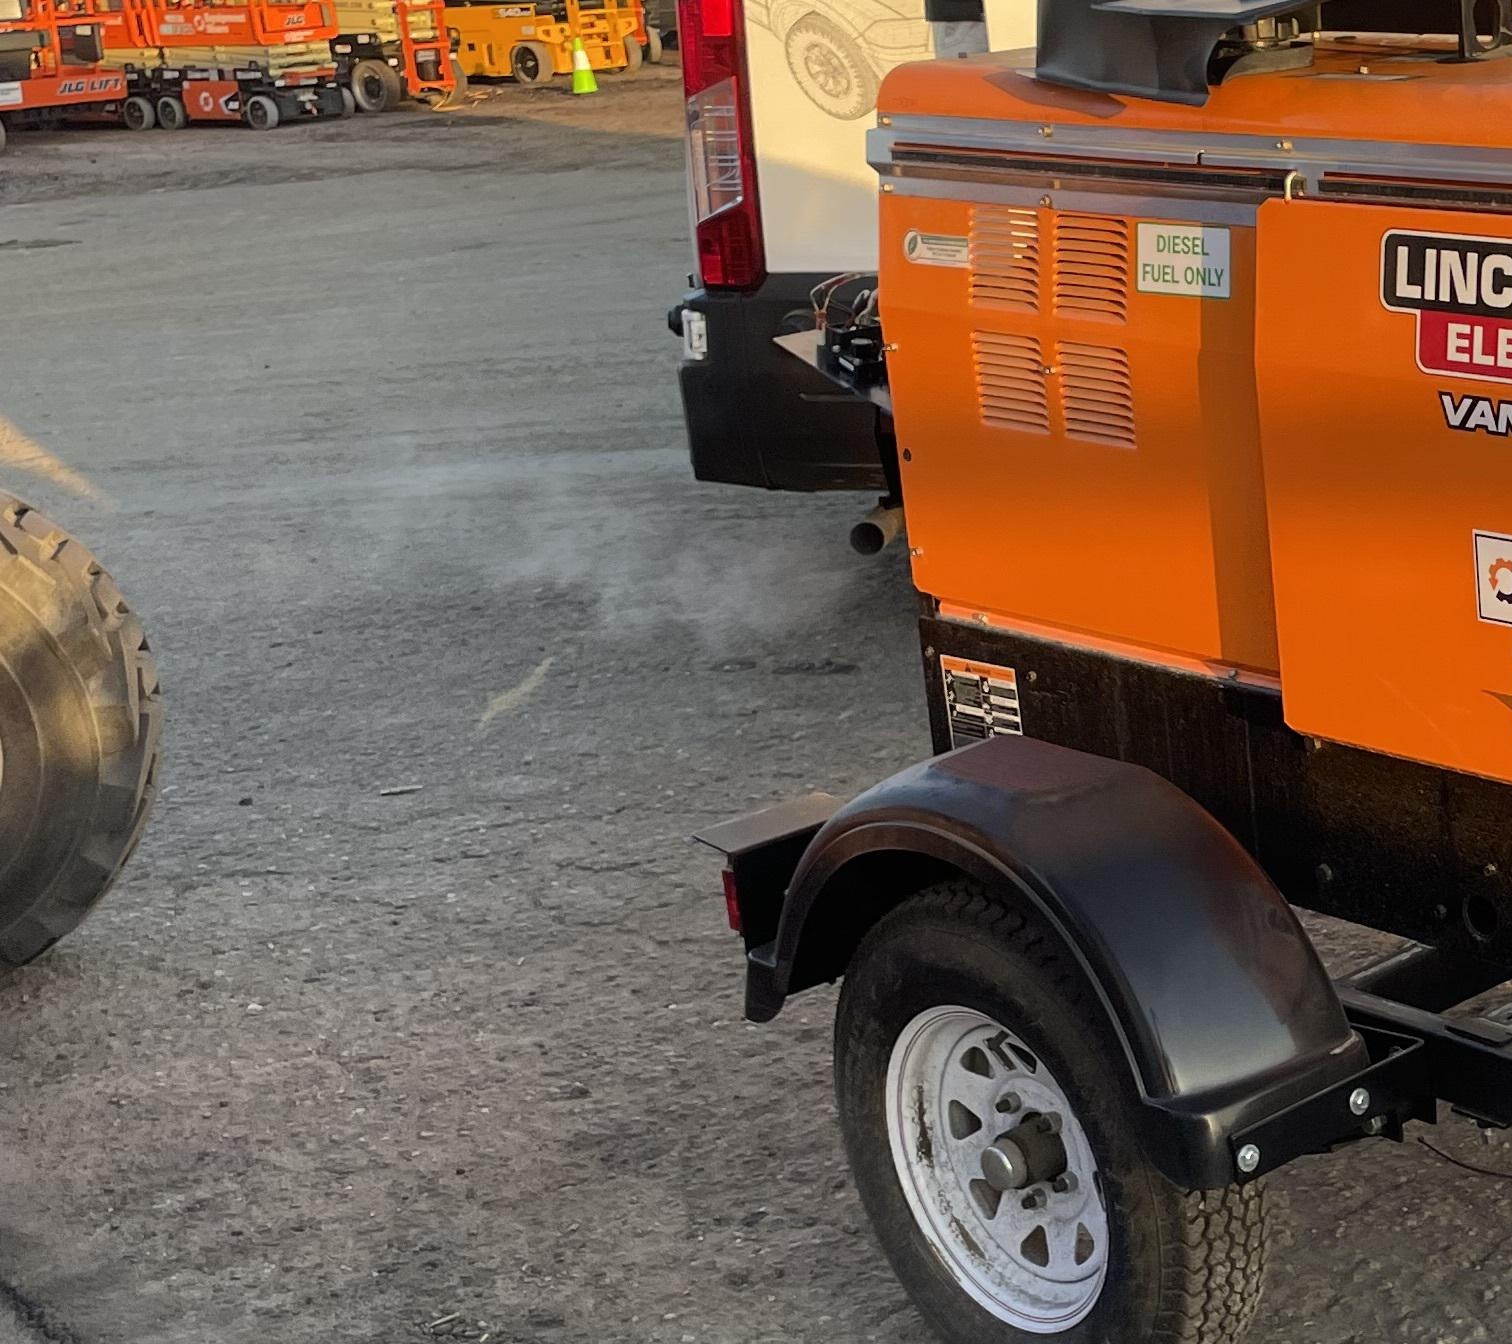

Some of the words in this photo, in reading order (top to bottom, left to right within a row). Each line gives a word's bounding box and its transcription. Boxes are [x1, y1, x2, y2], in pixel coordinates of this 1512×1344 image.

[60, 81, 85, 94] JLG
[90, 78, 121, 91] LIFT
[1156, 234, 1210, 256] DIESEL
[1142, 263, 1180, 284] FUEL
[1184, 266, 1225, 287] ONLY
